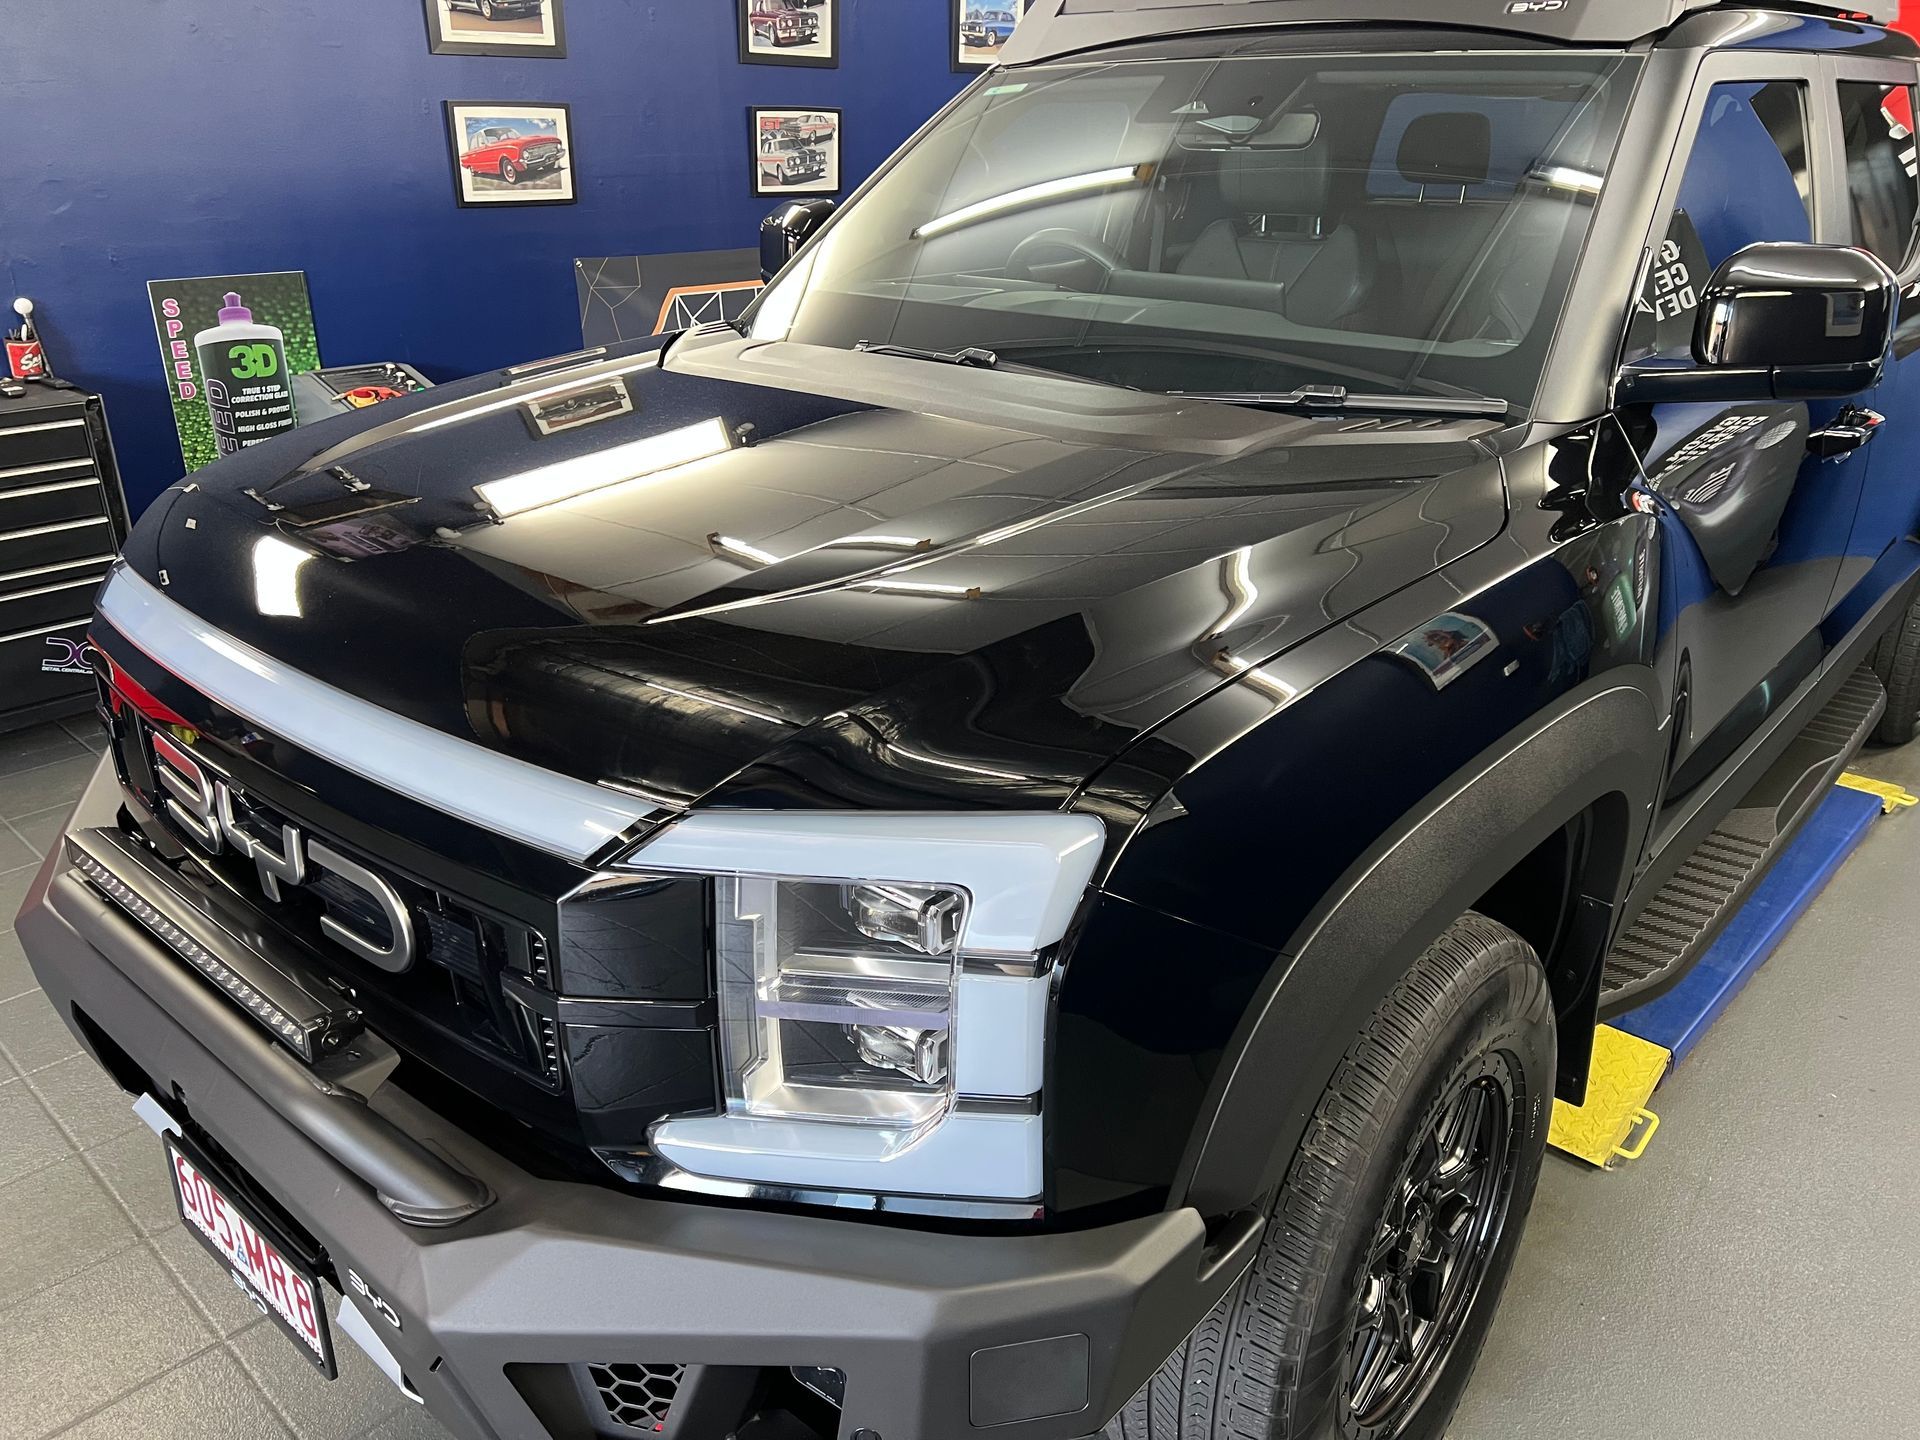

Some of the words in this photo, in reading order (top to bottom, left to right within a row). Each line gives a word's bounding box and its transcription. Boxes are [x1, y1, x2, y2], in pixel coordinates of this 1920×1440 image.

[1511, 1, 1562, 12] BYD
[761, 118, 784, 129] GT
[162, 298, 197, 400] SPEED
[228, 344, 278, 379] 3D
[242, 387, 261, 395] TRUE
[266, 384, 281, 392] STEP
[231, 392, 274, 404] CORRECTION
[235, 408, 261, 419] POLISH
[268, 404, 290, 415] PROTECT
[237, 424, 256, 433] HIGH
[256, 421, 277, 431] GLOSS
[151, 731, 416, 974] BYD
[231, 1269, 268, 1315] BYD
[349, 1269, 400, 1328] BYD
